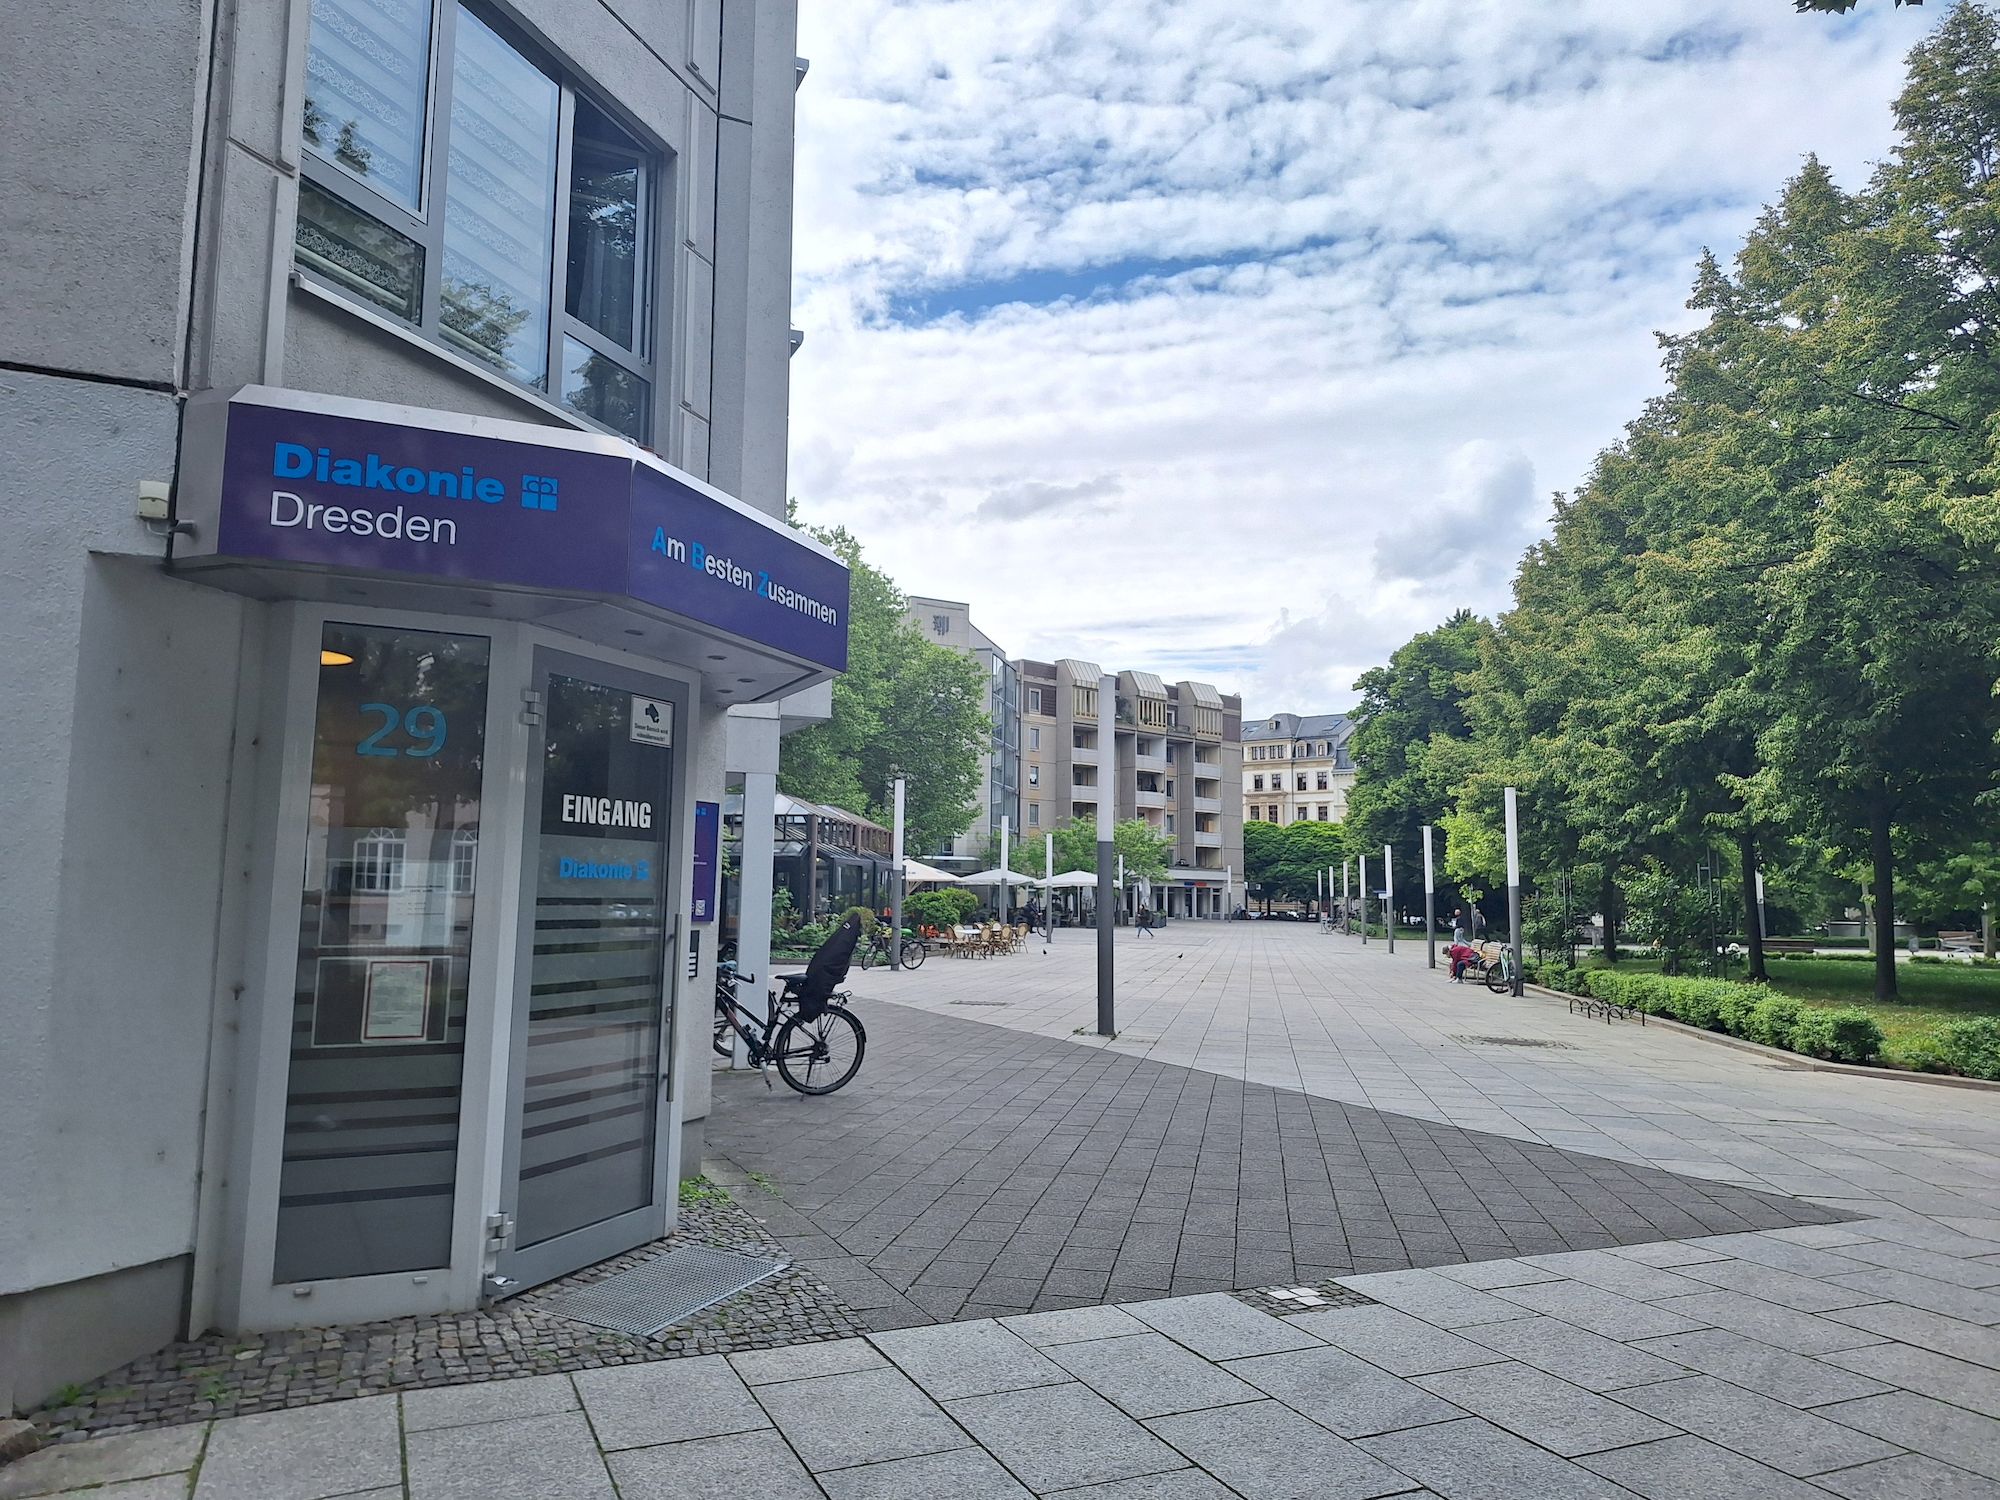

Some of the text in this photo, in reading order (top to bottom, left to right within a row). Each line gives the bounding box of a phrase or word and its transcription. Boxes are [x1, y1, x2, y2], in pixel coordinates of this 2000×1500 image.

[273, 442, 505, 503] Diakonie
[270, 490, 457, 545] Dresden
[652, 526, 838, 626] Am Besten Zusammen
[356, 703, 447, 758] 29
[562, 794, 652, 829] EINGANG
[560, 856, 633, 880] Diakonie
